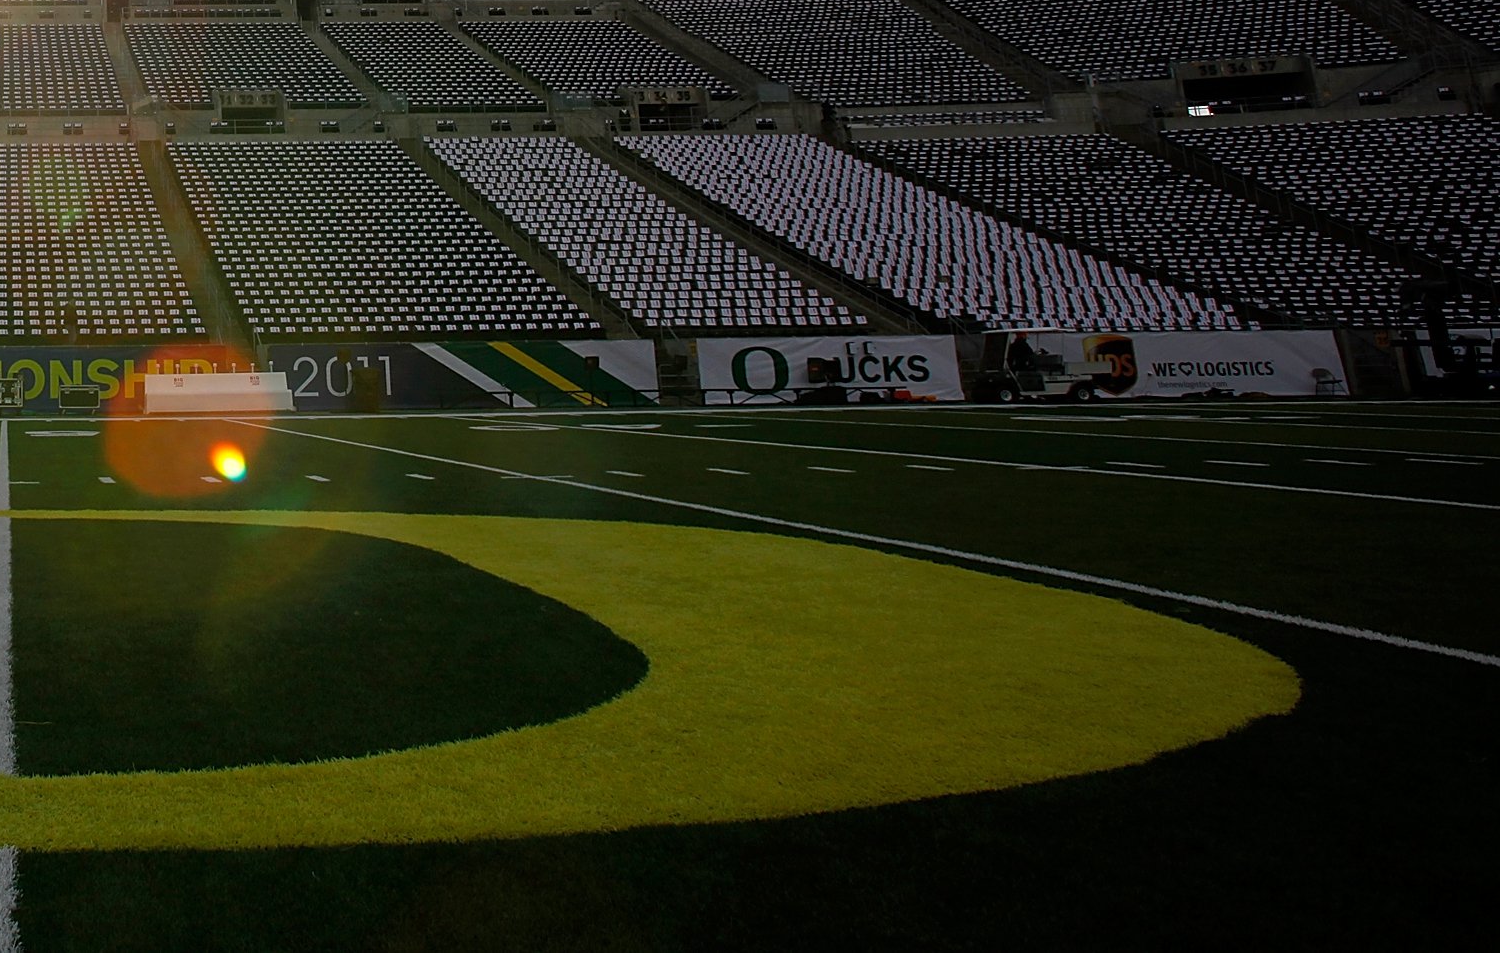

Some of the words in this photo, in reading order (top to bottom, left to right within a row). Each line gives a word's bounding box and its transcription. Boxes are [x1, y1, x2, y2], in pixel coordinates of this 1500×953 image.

[293, 355, 392, 397] 201
[830, 355, 930, 383] UCKS
[1152, 362, 1177, 376] WE
[1196, 361, 1274, 377] LOGISTICS
